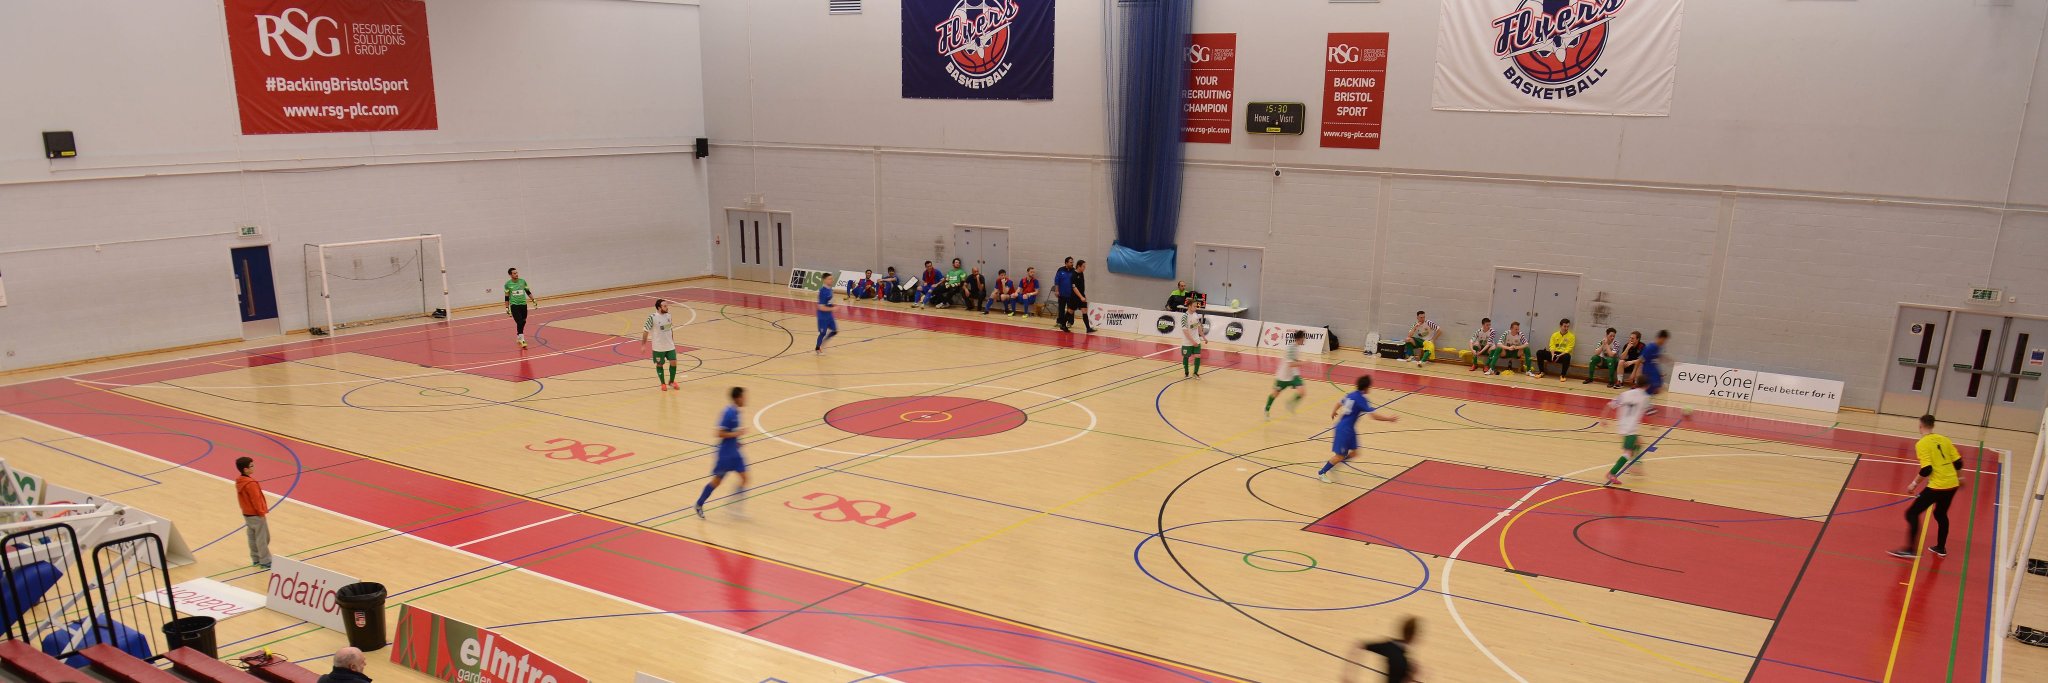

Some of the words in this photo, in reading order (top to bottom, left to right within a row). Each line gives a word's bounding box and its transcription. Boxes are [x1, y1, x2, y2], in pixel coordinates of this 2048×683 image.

[254, 7, 341, 61] RSG
[352, 23, 403, 35] RESOURCE
[353, 34, 406, 46] SOLUTIONS
[354, 45, 388, 55] GROUP
[1328, 43, 1360, 64] RSG
[945, 61, 1012, 89] BASKETBALL
[1195, 76, 1218, 86] YOUR
[265, 77, 409, 95] #BackingBristolSport
[1333, 77, 1376, 88] BACKING
[1503, 66, 1608, 100] BASKETBALL
[1181, 89, 1232, 99] RECRUITING
[1333, 91, 1373, 102] BRISTOL
[283, 102, 399, 119] www.rsg-plc.com
[1183, 103, 1228, 113] CHAMPION
[1336, 106, 1368, 117] SPORT
[1323, 130, 1379, 139] www.rsg-plc.com
[1106, 312, 1138, 320] COMMUNITY
[1678, 369, 1752, 389] everyone
[1709, 389, 1750, 401] ACTIVE
[1757, 383, 1778, 393] Feel
[1779, 386, 1810, 397] better
[1811, 389, 1826, 399] for
[1827, 391, 1835, 400] it
[1936, 444, 1946, 460] 1
[267, 571, 341, 616] ndatio
